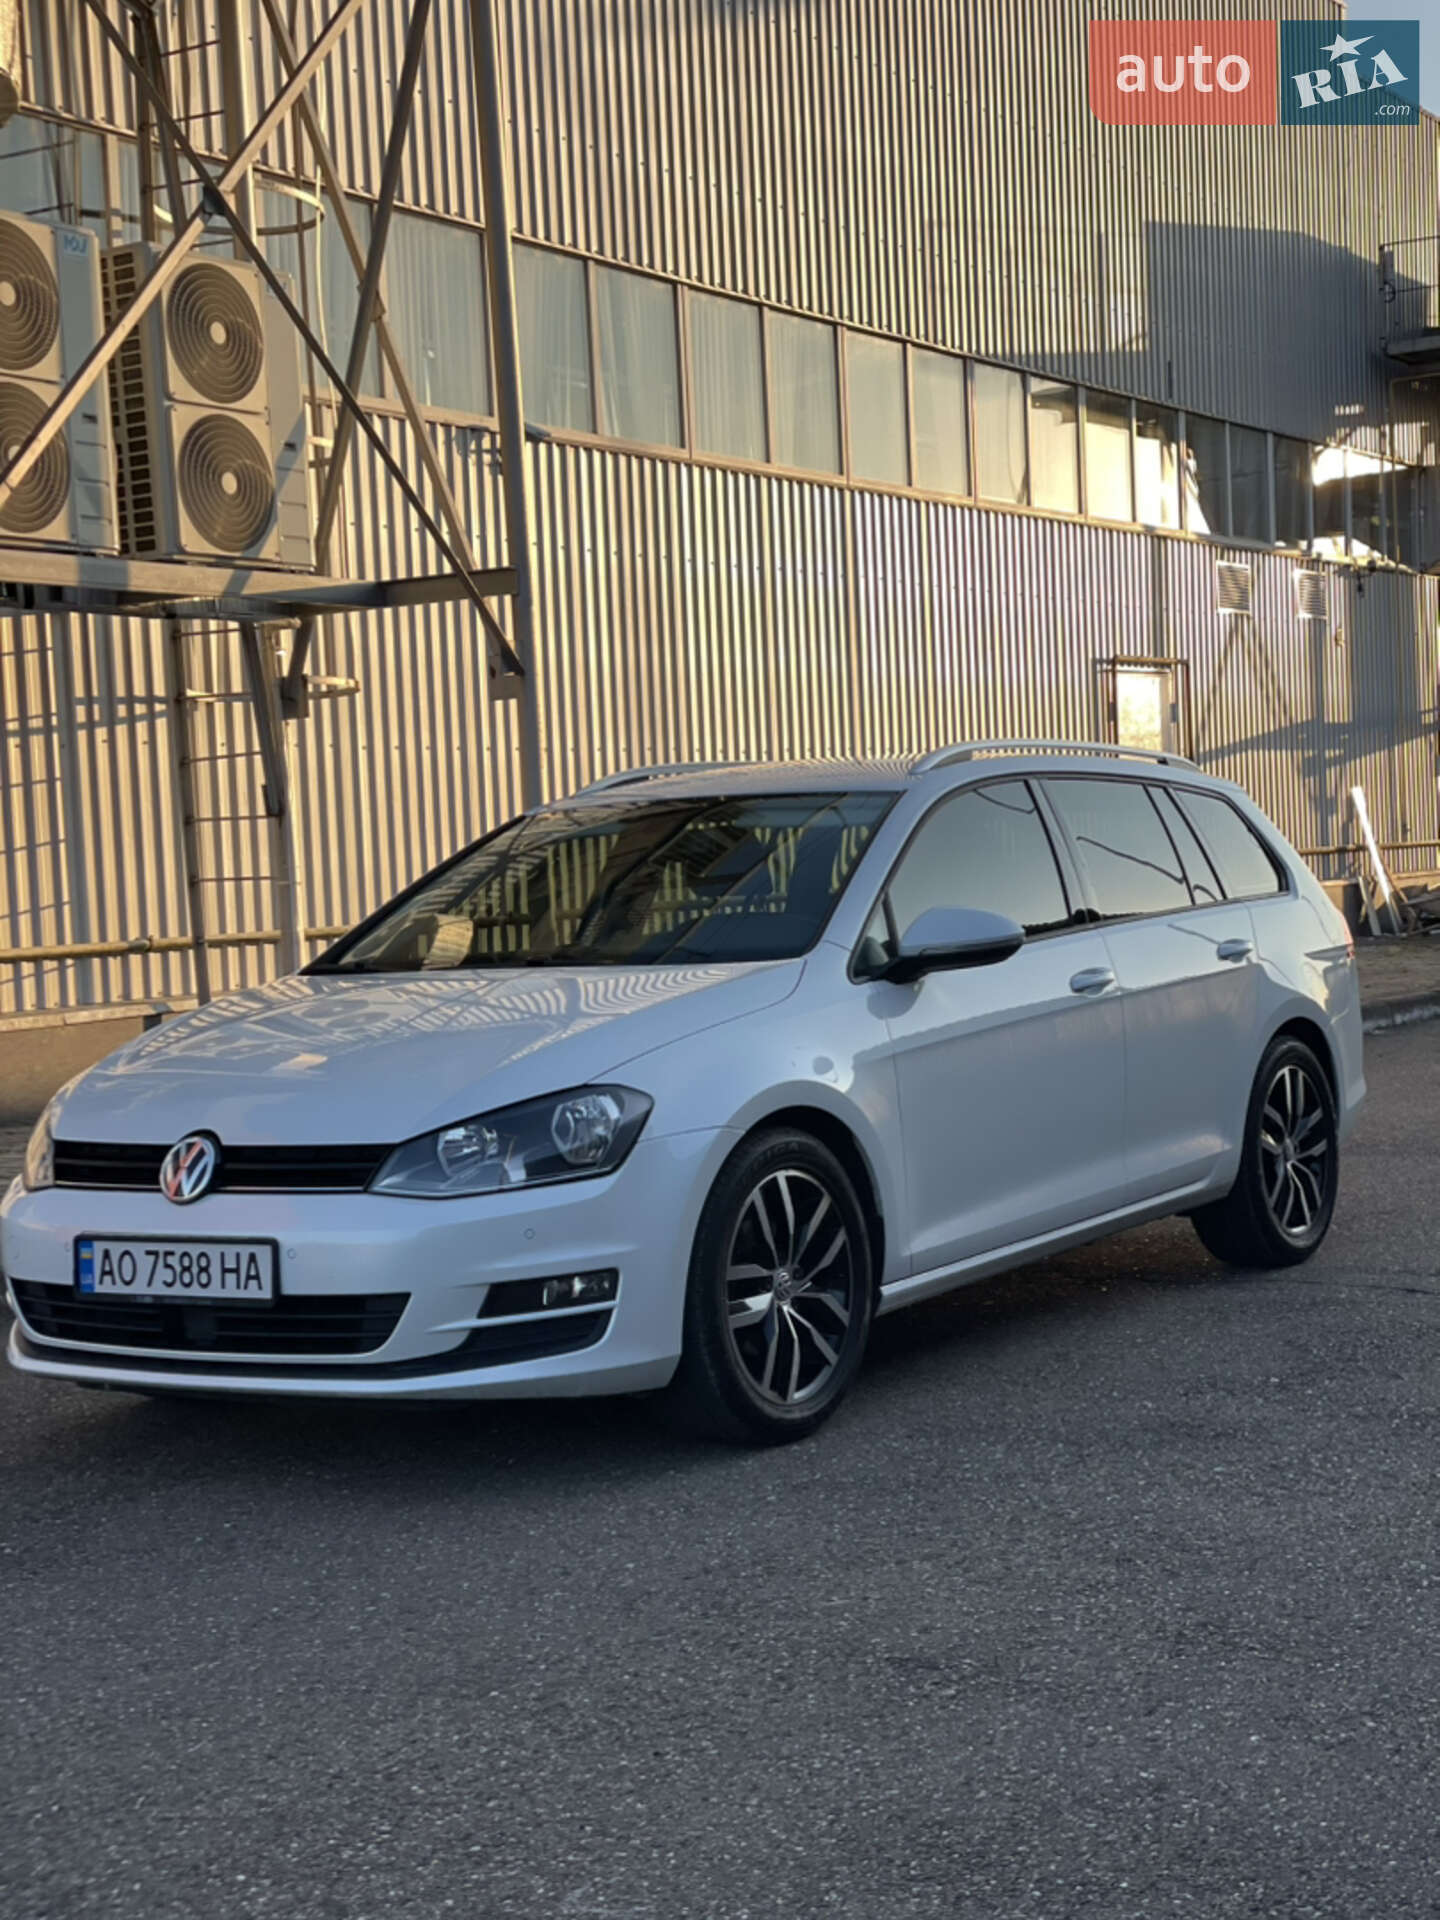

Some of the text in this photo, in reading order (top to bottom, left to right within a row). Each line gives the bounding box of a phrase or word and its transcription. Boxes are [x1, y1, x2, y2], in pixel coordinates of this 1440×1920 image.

[98, 1248, 263, 1291] AO 7588 HA
